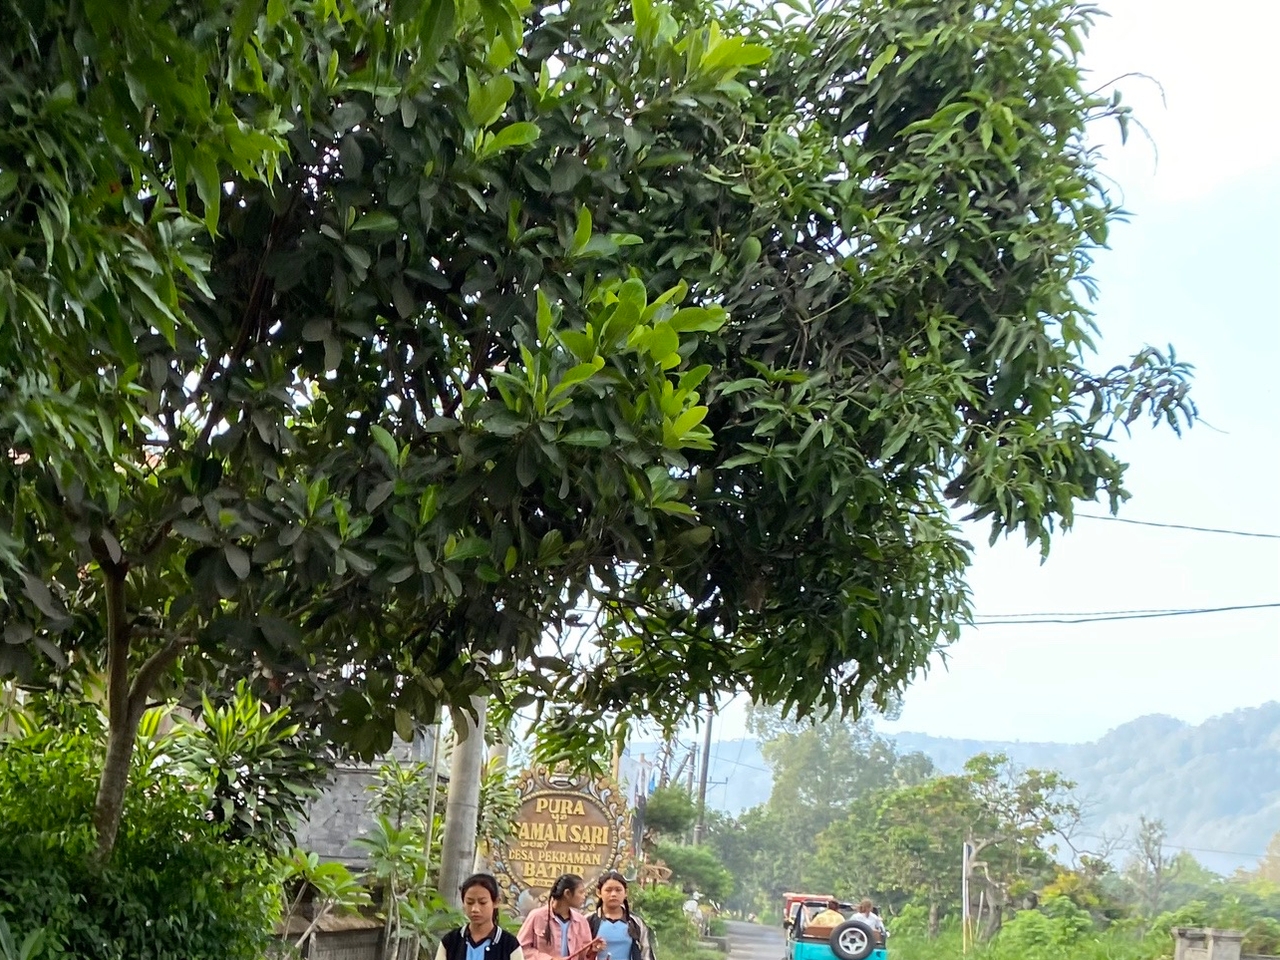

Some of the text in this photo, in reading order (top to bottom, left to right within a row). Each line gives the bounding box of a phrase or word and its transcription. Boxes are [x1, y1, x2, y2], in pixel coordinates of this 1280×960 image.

[536, 798, 585, 815] PURA
[569, 825, 609, 845] SARI
[538, 851, 601, 865] PEKRAMAN
[523, 862, 584, 879] BATUR
